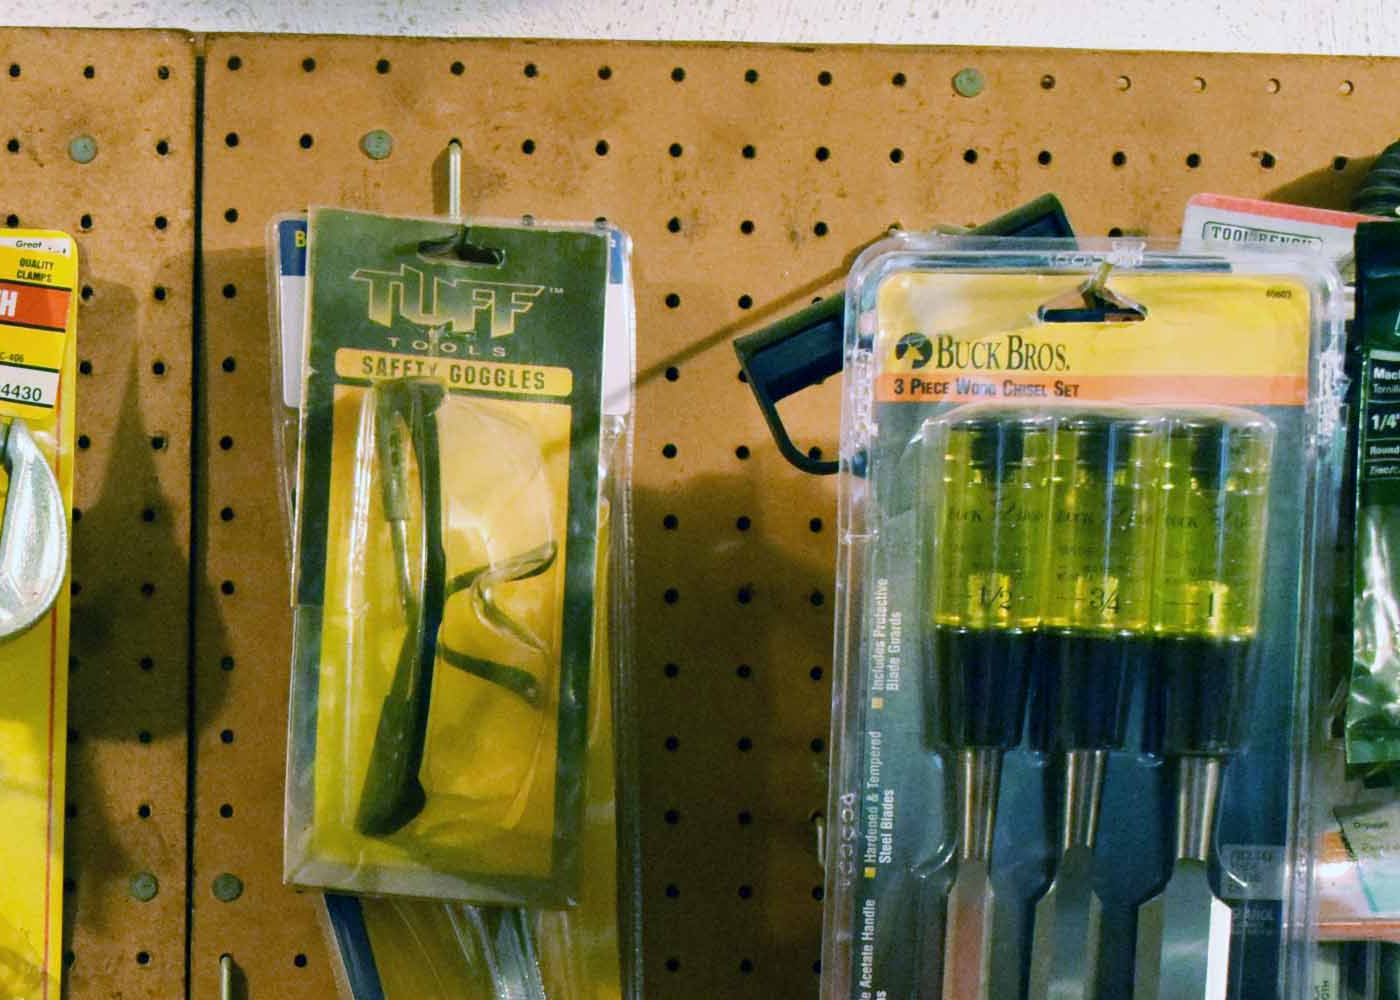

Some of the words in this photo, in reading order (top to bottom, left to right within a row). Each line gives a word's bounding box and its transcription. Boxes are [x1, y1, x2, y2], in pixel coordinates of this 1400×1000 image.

[16, 269, 53, 283] CLAMPS
[19, 257, 55, 270] QUALITY
[350, 263, 546, 339] TUFF
[387, 336, 507, 358] TOOLS
[936, 334, 1001, 370] BUCK
[1005, 335, 1071, 372] BROS.
[449, 364, 546, 391] GOGGLES
[893, 378, 905, 396] 3
[1053, 379, 1080, 398] SET
[873, 578, 889, 638] Protective
[887, 611, 902, 653] Guards
[871, 640, 886, 690] Includes
[886, 656, 901, 691] Blade
[867, 731, 883, 789] Tempered
[880, 789, 895, 830] Blades
[864, 806, 879, 863] Hardened
[879, 834, 893, 864] Steel
[861, 899, 876, 941] Handle
[859, 944, 874, 989] Acetate
